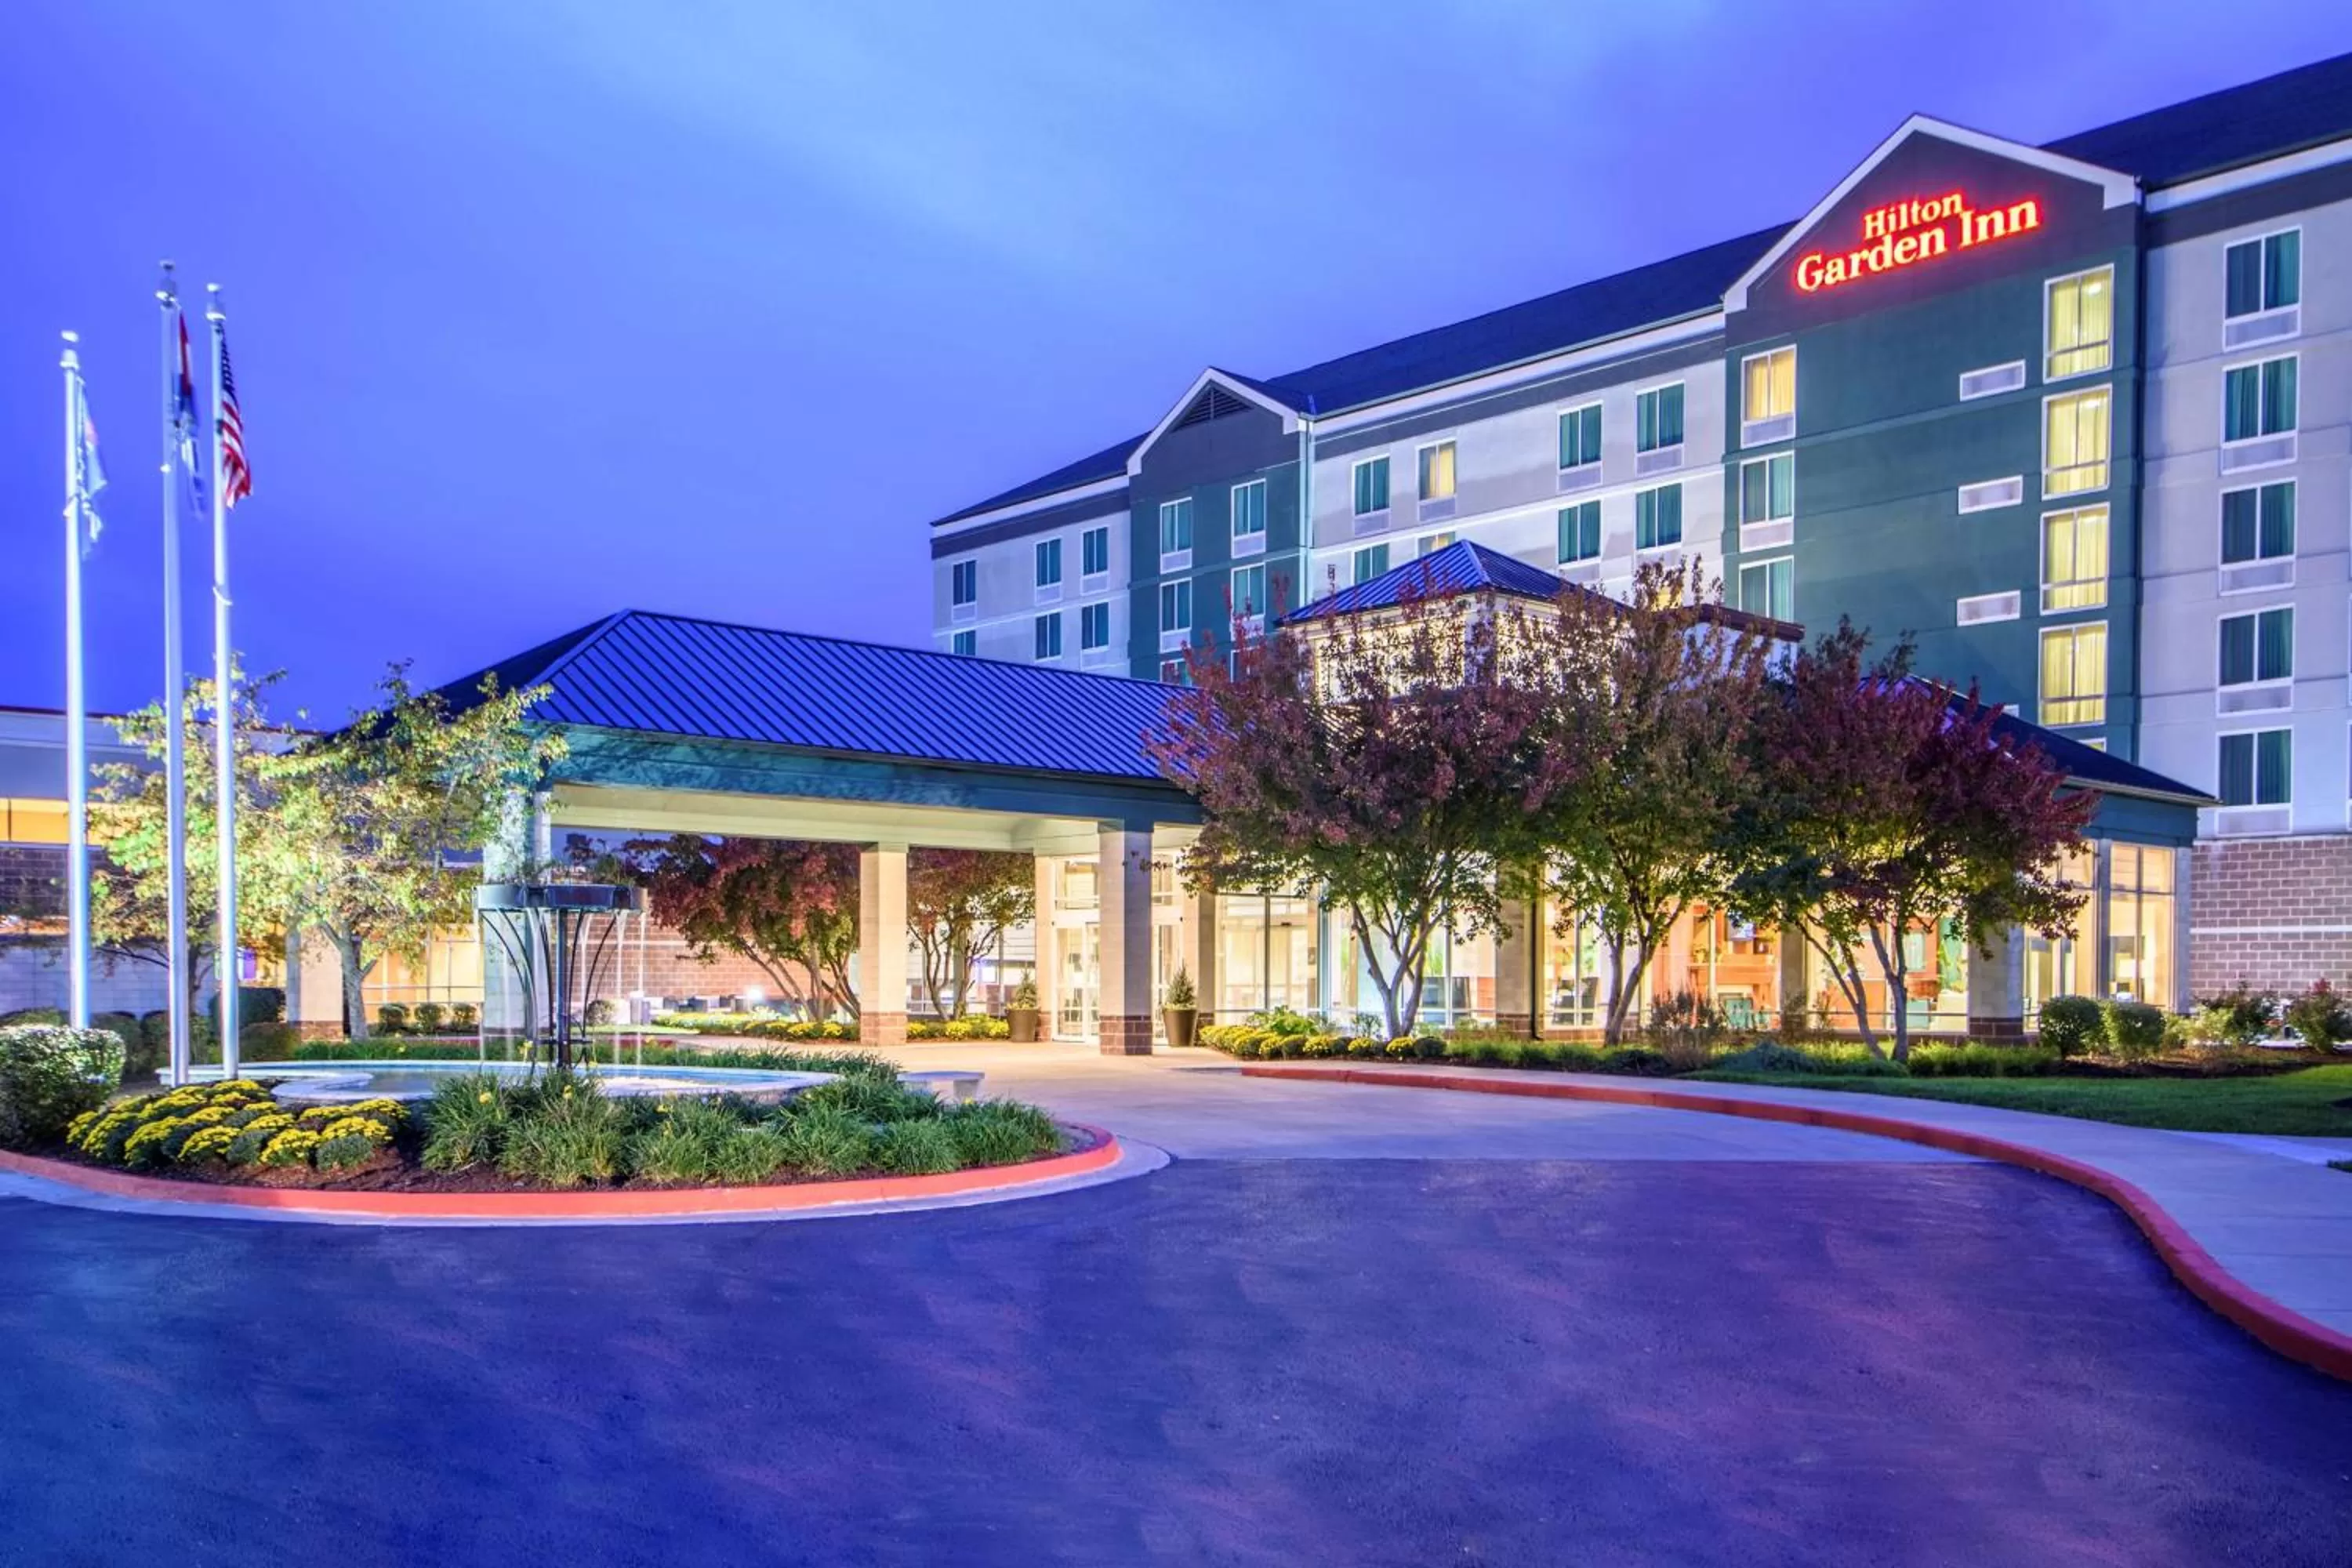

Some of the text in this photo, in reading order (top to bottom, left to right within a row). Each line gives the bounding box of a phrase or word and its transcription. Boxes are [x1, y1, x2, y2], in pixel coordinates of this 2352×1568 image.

[1796, 200, 2039, 291] Garden Inn
[1864, 193, 1963, 239] Hilton
